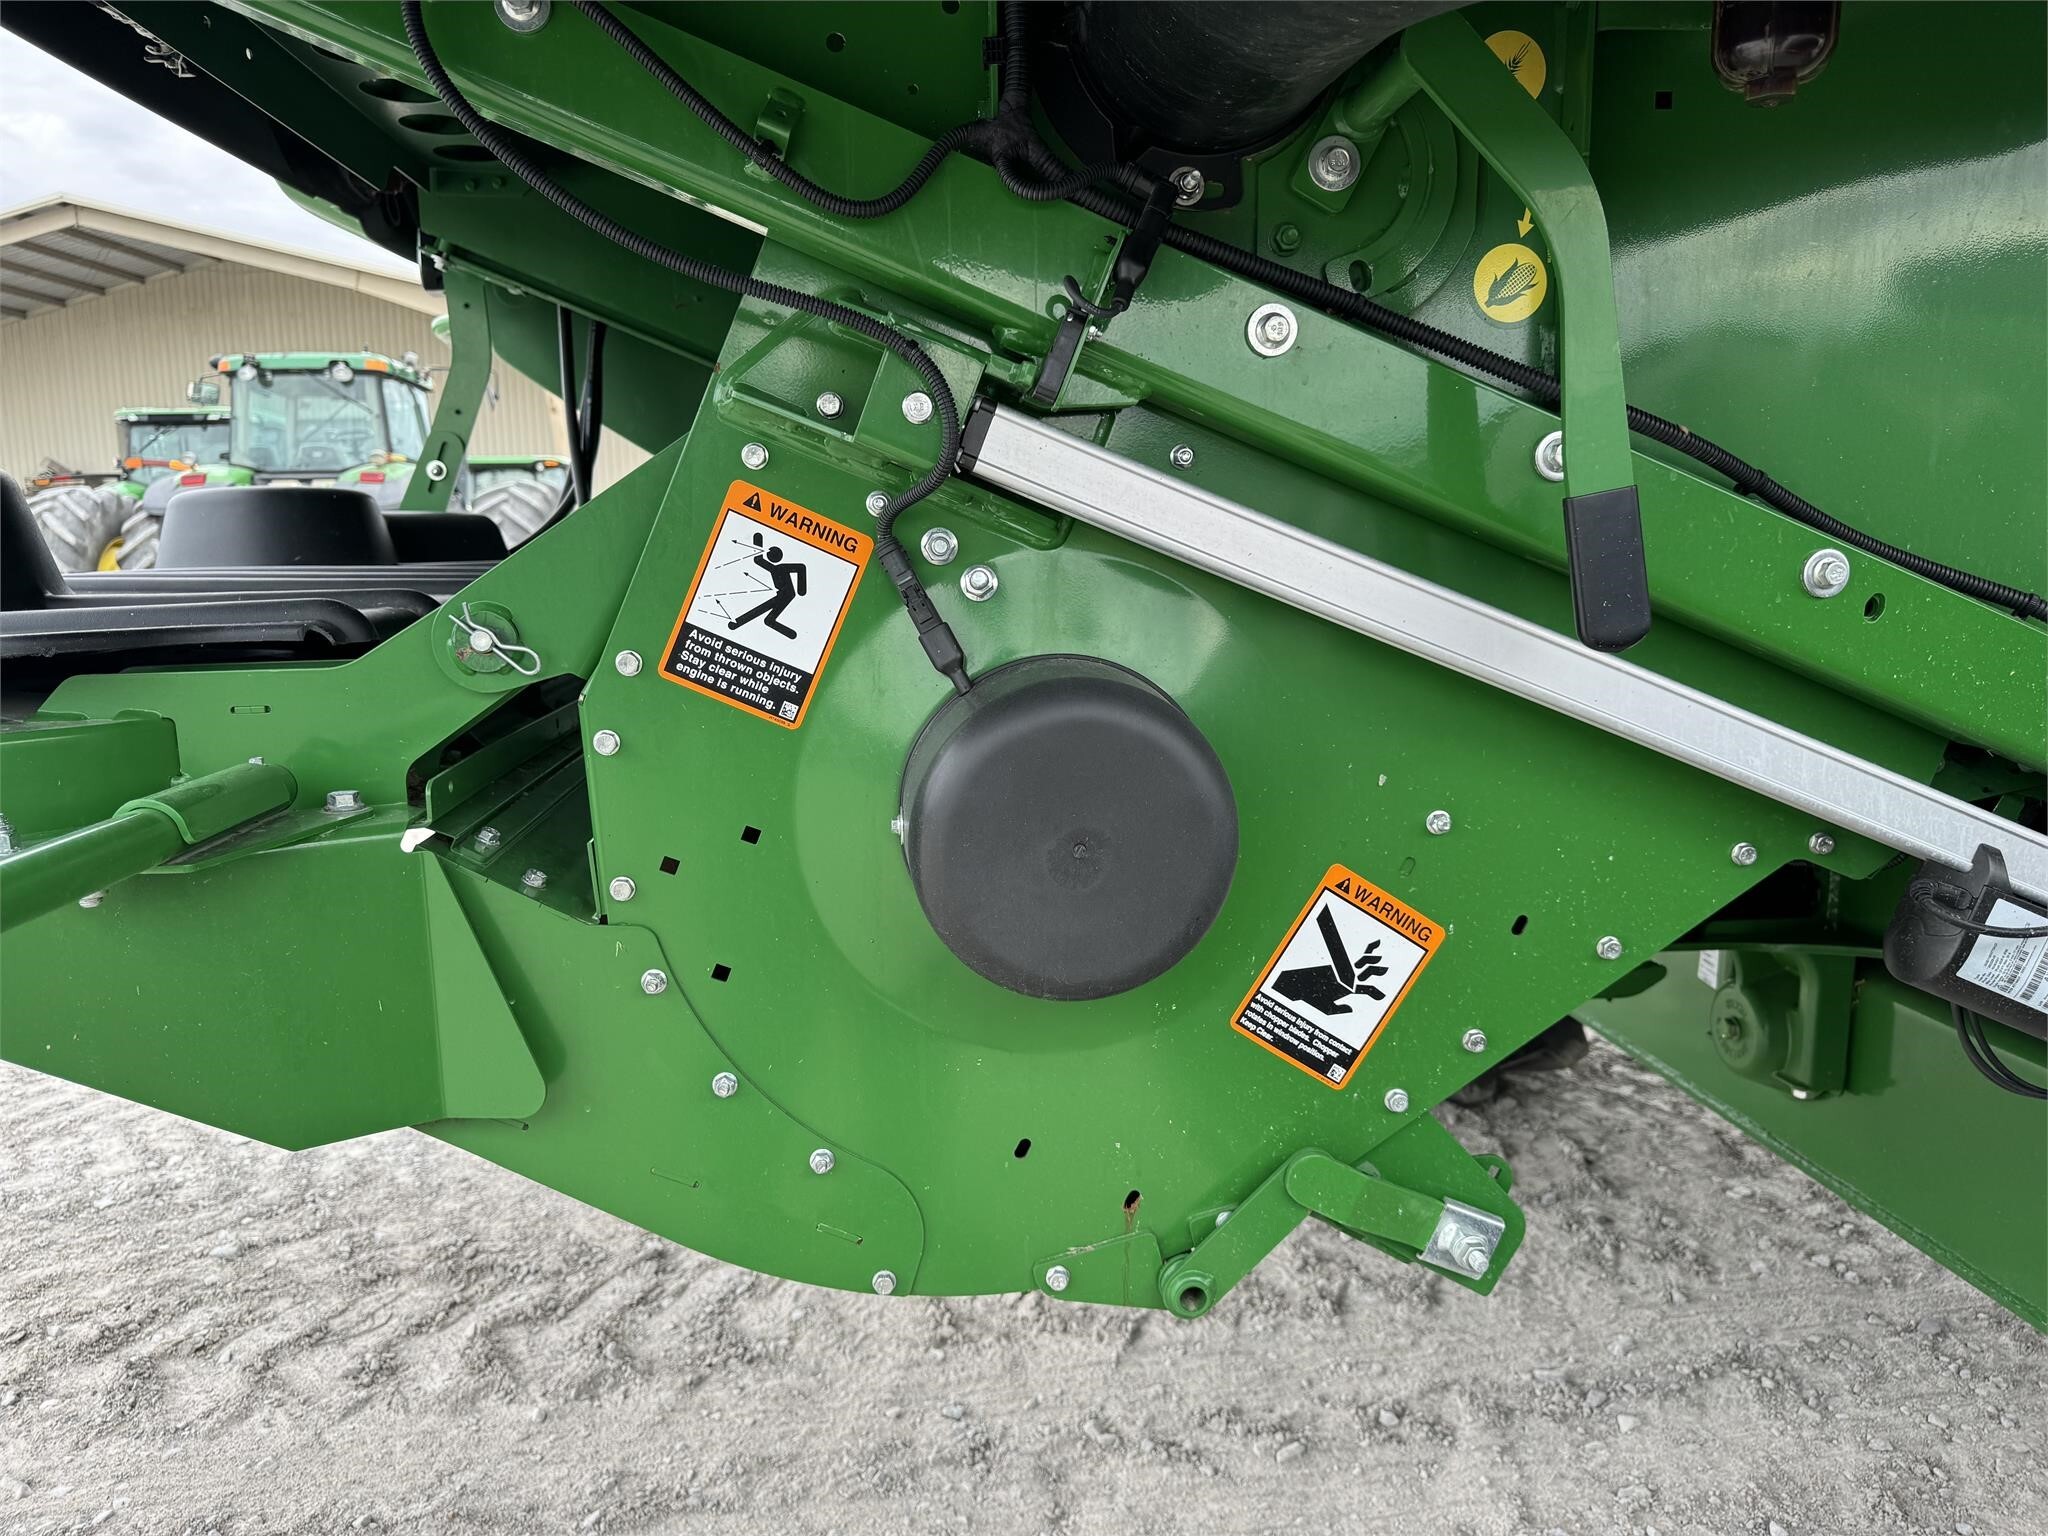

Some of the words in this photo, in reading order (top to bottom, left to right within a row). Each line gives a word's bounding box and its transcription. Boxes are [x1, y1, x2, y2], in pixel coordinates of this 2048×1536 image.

[770, 502, 859, 553] WARNING
[681, 650, 707, 670] Stay
[709, 663, 738, 681] clear
[740, 675, 770, 694] while
[685, 639, 712, 658] from
[715, 652, 754, 675] thrown
[756, 670, 799, 694] objects.
[689, 628, 724, 650] Avoid
[725, 645, 767, 668] serious
[769, 661, 803, 684] injury
[676, 662, 715, 684] engine
[717, 677, 728, 690] is
[730, 684, 776, 710] running.
[1354, 885, 1432, 942] WARNING
[1240, 1016, 1257, 1031] Keep
[1256, 1026, 1274, 1042] Clear.
[1245, 1009, 1268, 1026] rotates
[1266, 1021, 1274, 1031] in
[1274, 1026, 1300, 1046] windrow
[1298, 1042, 1325, 1062] position.
[1251, 1001, 1265, 1014] with
[1264, 1009, 1290, 1029] chopper
[1288, 1024, 1310, 1043] blades.
[1313, 1038, 1340, 1058] Chopper
[1255, 993, 1276, 1009] Avoid
[1274, 1004, 1297, 1023] serious
[1296, 1017, 1315, 1034] injury
[1314, 1028, 1330, 1042] from
[1329, 1038, 1353, 1056] contact
